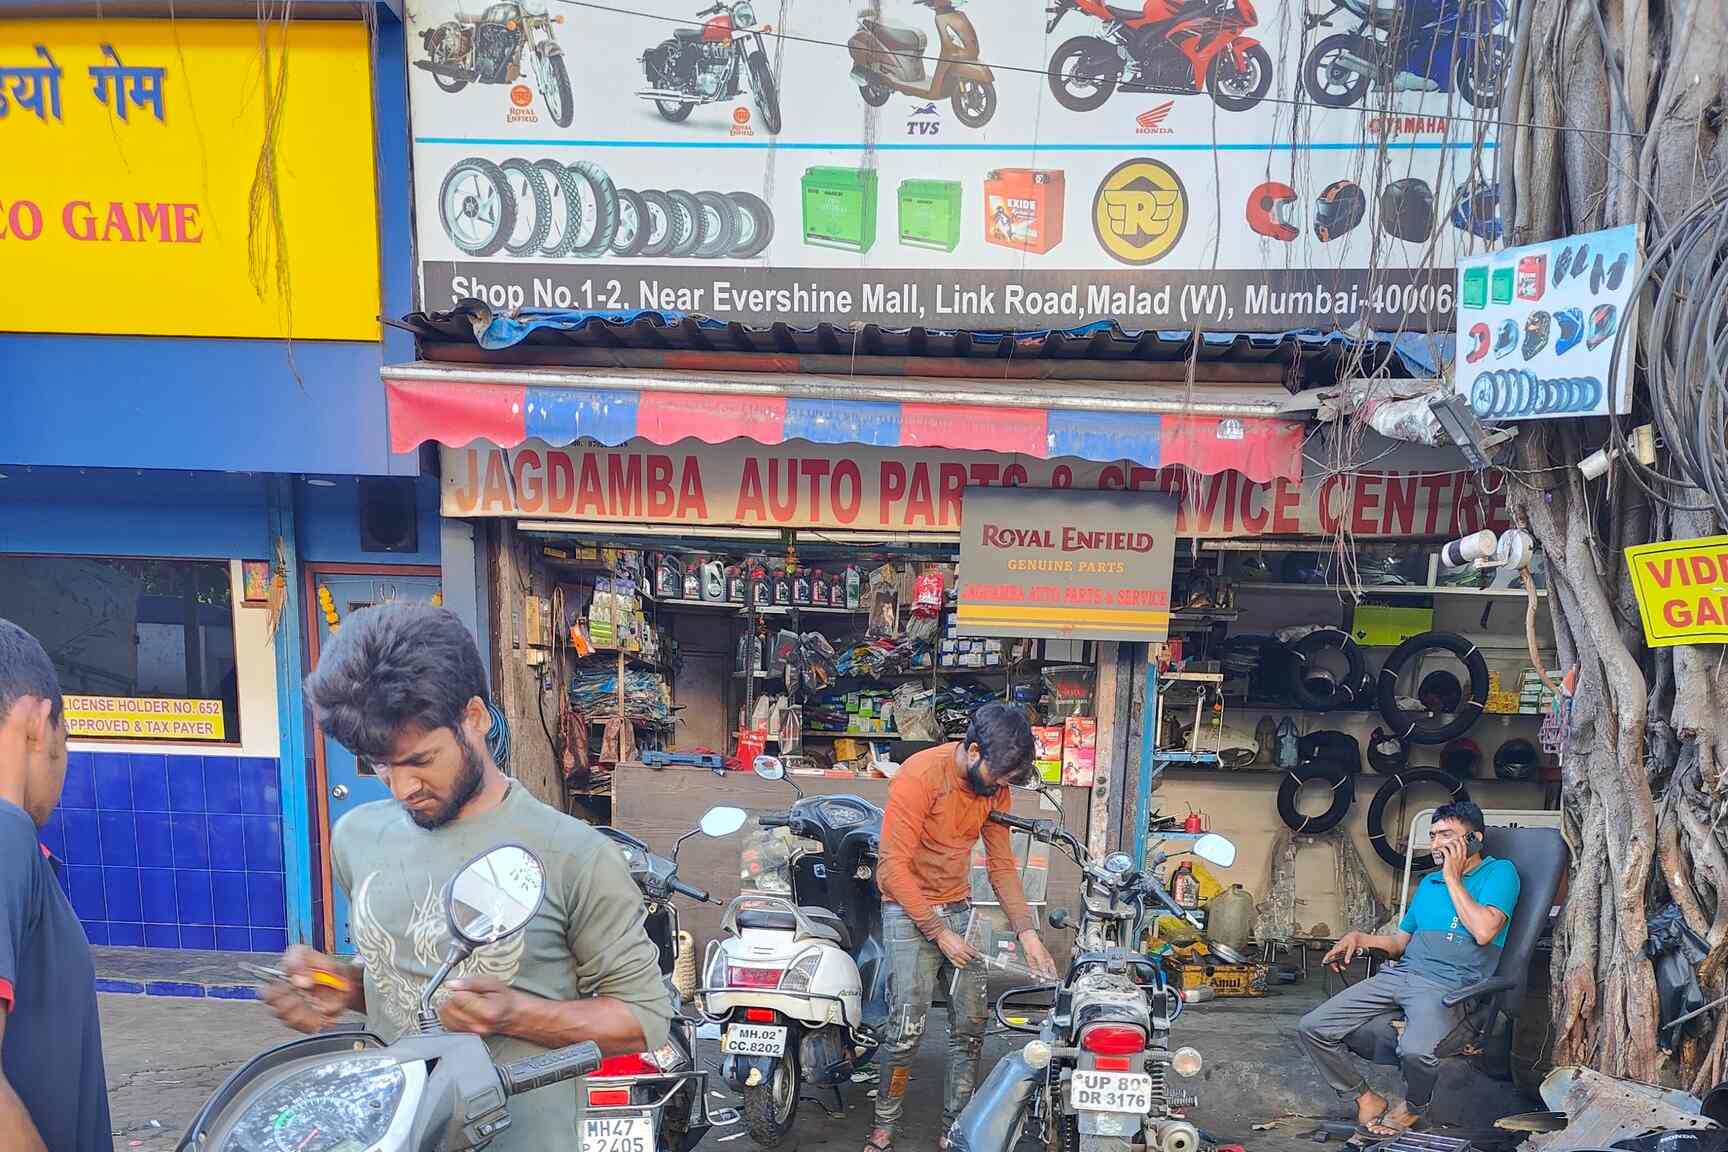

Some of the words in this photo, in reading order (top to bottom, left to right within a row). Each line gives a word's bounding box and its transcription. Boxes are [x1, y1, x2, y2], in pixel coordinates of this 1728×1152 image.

[88, 44, 166, 123] गेम
[907, 122, 939, 135] TVS
[1007, 198, 1037, 209] EXIDE
[62, 200, 204, 244] GAME
[452, 276, 525, 310] Shop
[640, 284, 704, 312] Near
[714, 281, 854, 313] Evershine
[863, 283, 926, 318] Mall,
[936, 285, 995, 314] Link
[1180, 284, 1234, 320] (W),
[1245, 284, 1456, 317] Mumbai-40006
[456, 447, 709, 519] JAGDAMBA
[736, 456, 862, 524] AUTO
[1318, 470, 1511, 535] CENTRE
[982, 524, 1055, 548] ROYAL
[1062, 527, 1154, 553] ENFIELD
[1007, 559, 1073, 572] GENUINE
[1077, 561, 1125, 574] PARTS
[1064, 587, 1101, 604] PARTS
[1118, 589, 1169, 607] SERVICE
[118, 700, 170, 713] HOLDER
[174, 701, 196, 714] NO.
[199, 702, 219, 714] 652
[134, 720, 142, 732] &
[147, 721, 169, 734] TAX
[173, 722, 213, 735] PAYER
[739, 1029, 776, 1040] MH.02
[729, 1041, 781, 1054] CC.8202
[1085, 1075, 1111, 1090] UP
[1079, 1090, 1102, 1104] DR
[1106, 1092, 1145, 1108] 3176
[588, 1119, 634, 1137] MH47
